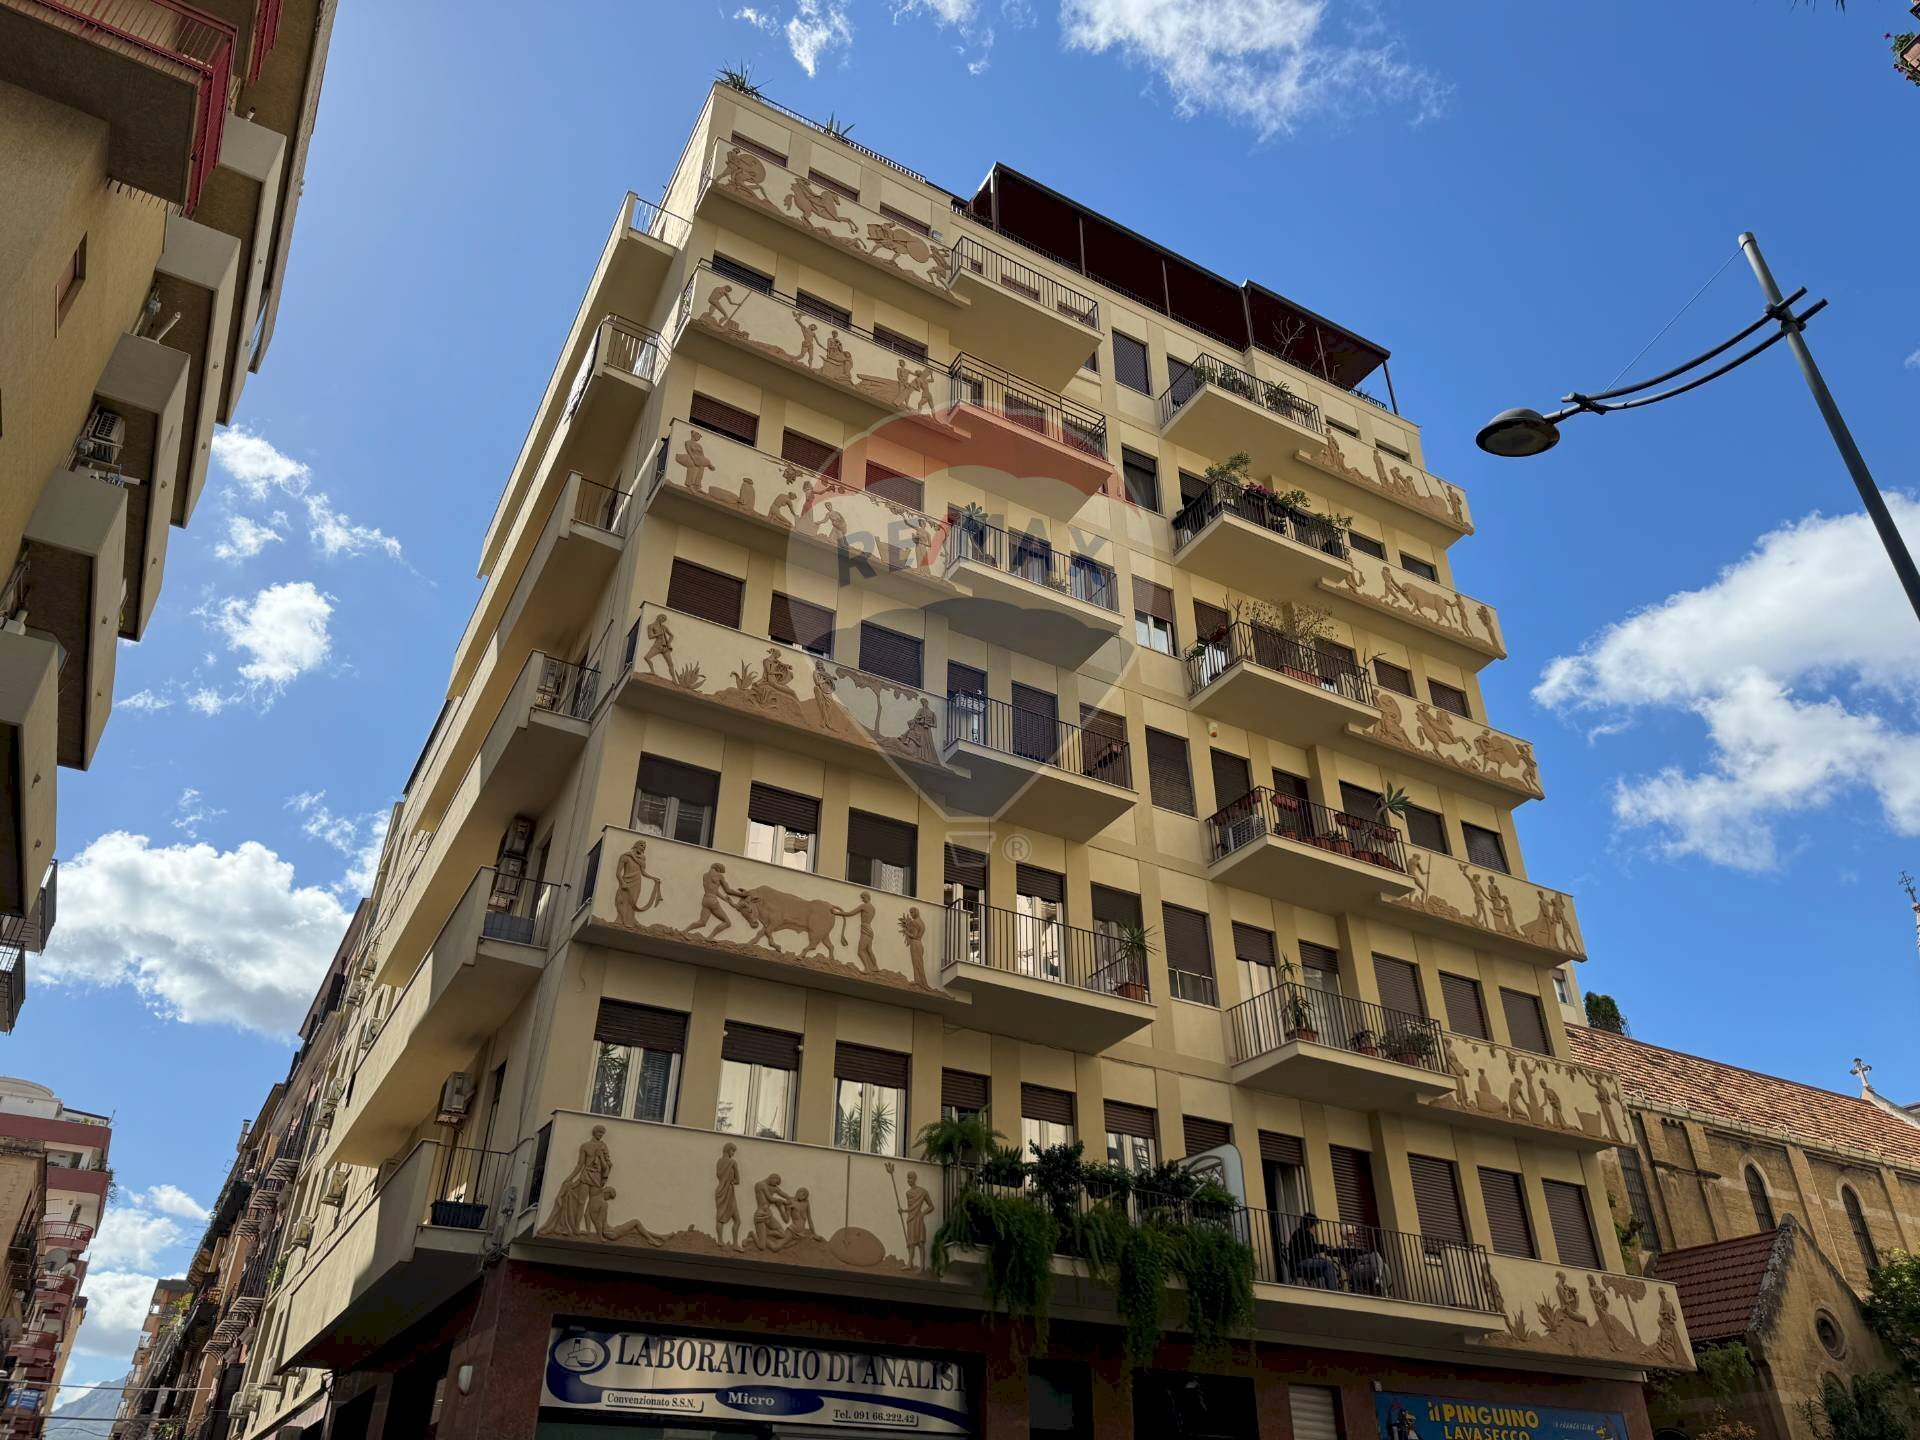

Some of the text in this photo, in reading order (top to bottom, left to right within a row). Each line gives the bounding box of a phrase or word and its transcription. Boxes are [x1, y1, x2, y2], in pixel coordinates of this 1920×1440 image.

[615, 1333, 964, 1392] LABORATORIO DI ANALISI
[607, 1392, 696, 1409] Convenzionato S.S.N.
[728, 1391, 775, 1407] Micro
[833, 1409, 851, 1419] Tel.
[853, 1410, 869, 1420] 091
[1442, 1403, 1539, 1429] PINGUINO
[1444, 1425, 1531, 1440] LAVASECCO
